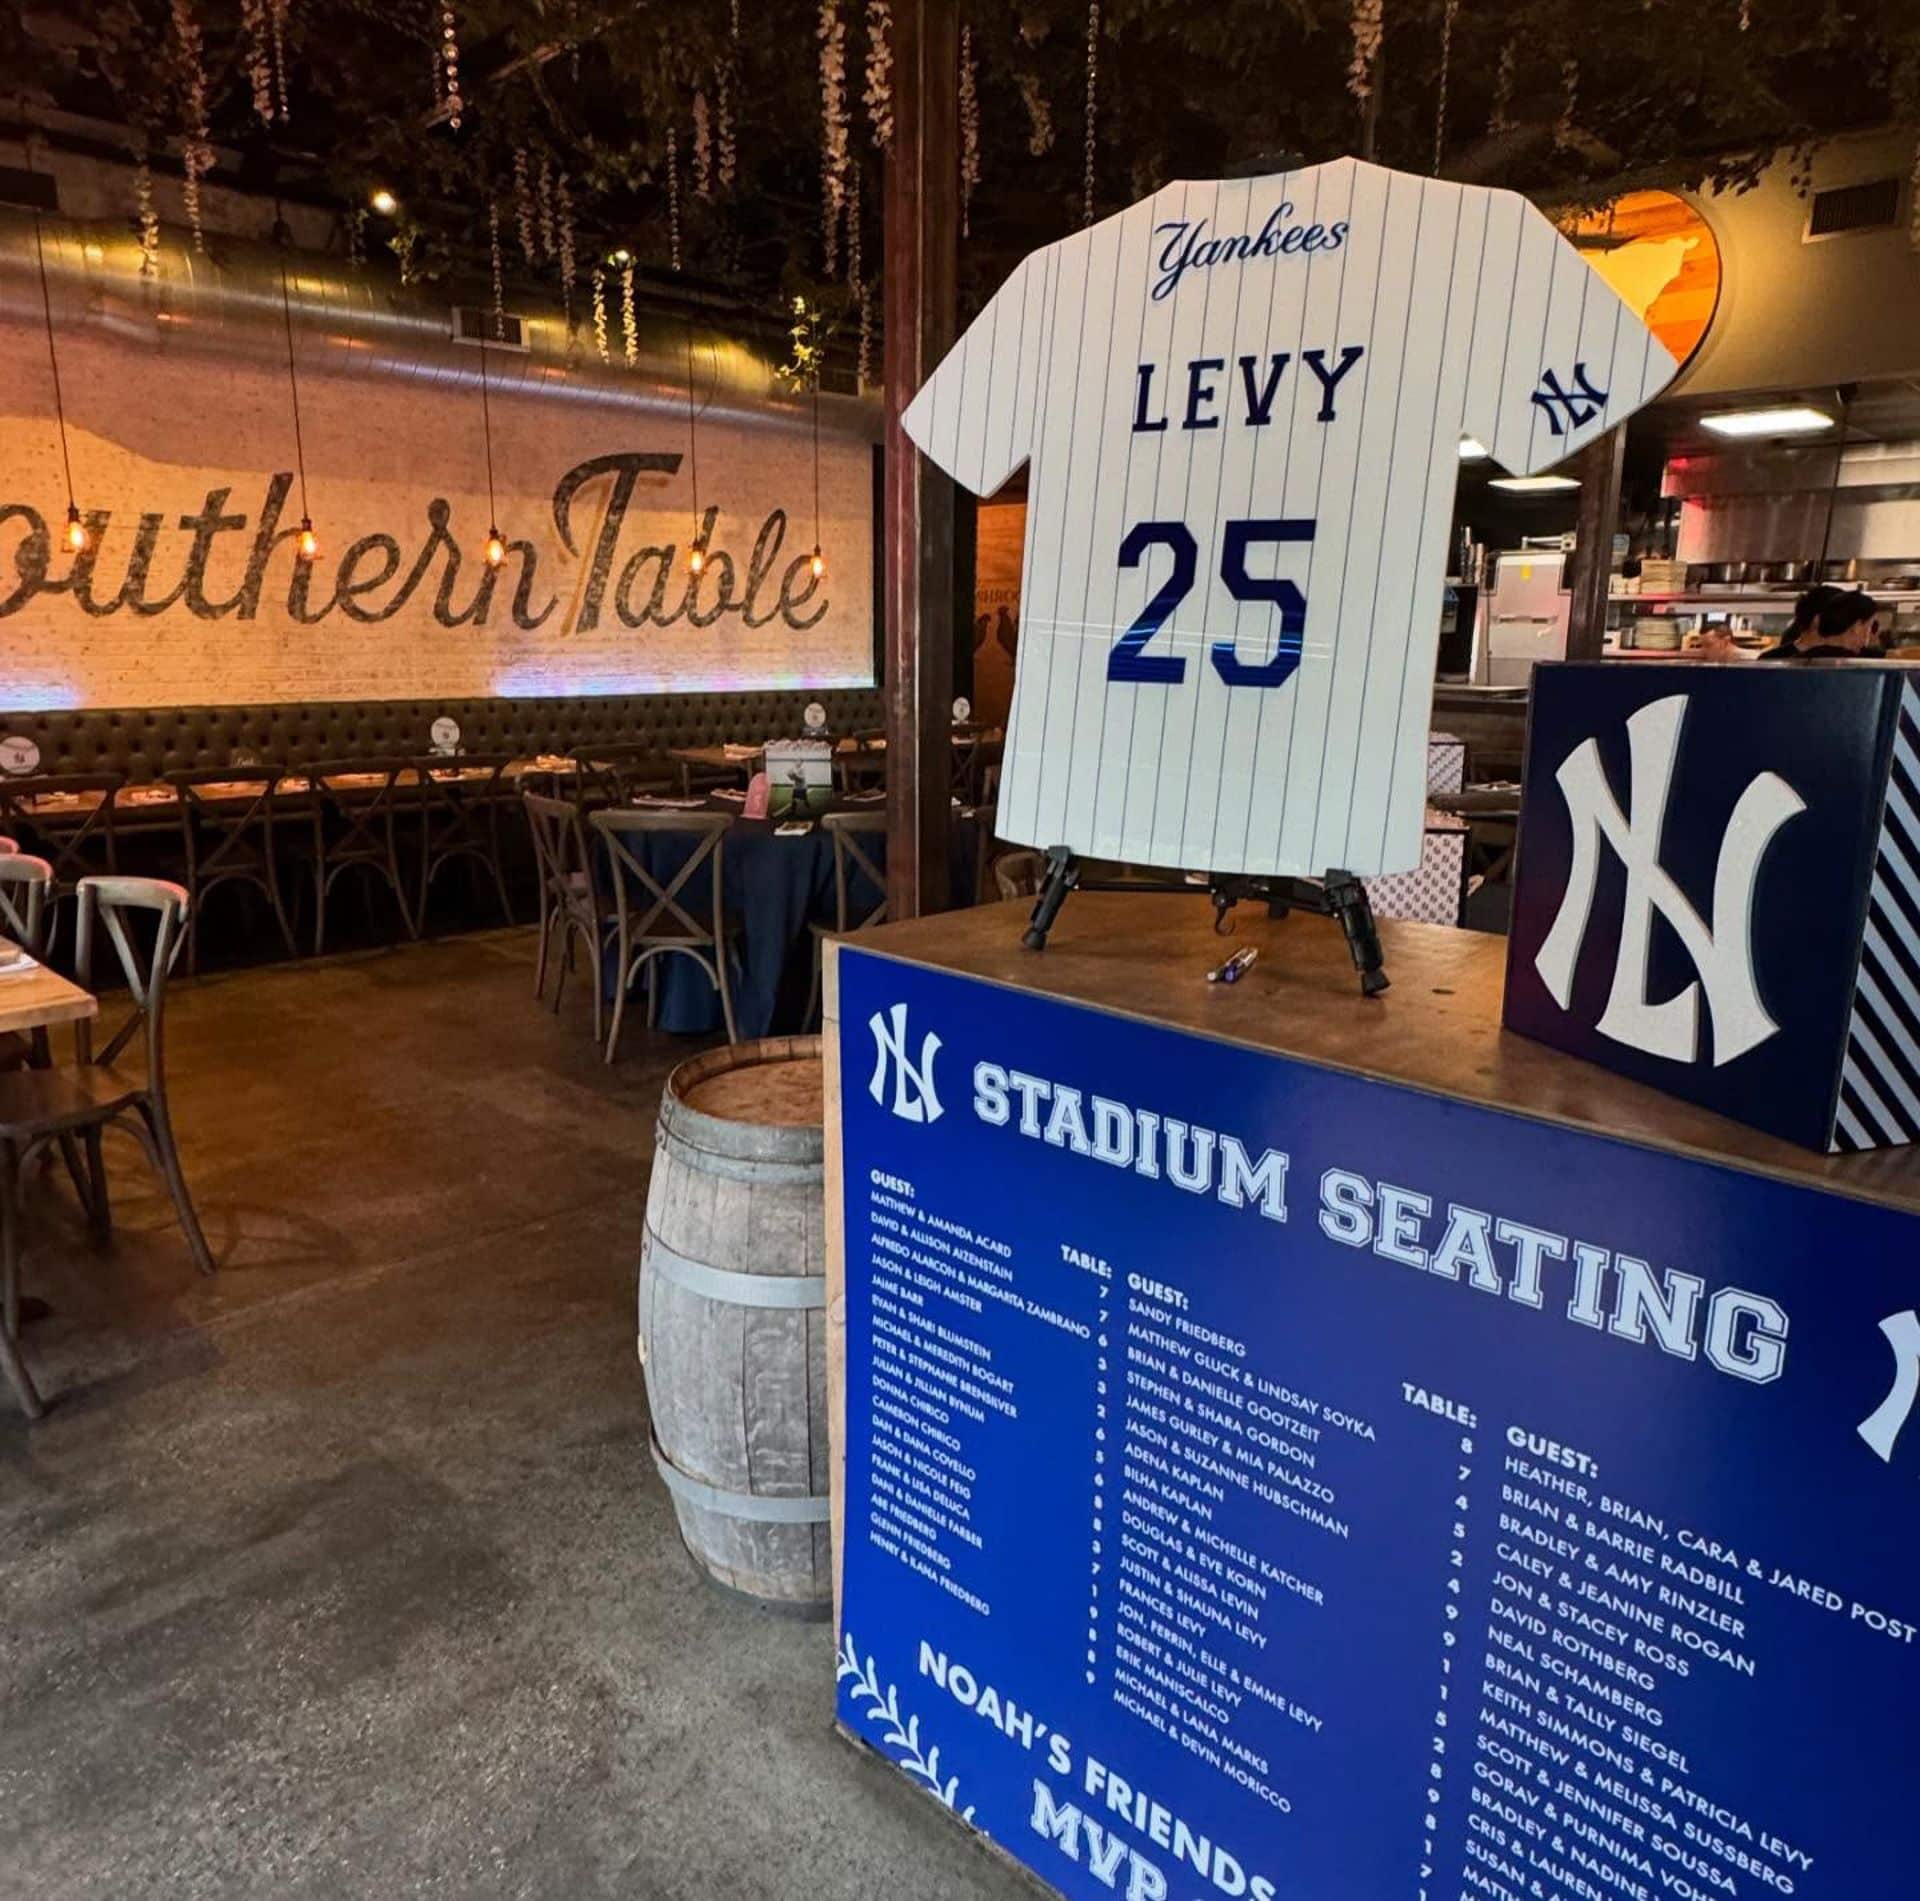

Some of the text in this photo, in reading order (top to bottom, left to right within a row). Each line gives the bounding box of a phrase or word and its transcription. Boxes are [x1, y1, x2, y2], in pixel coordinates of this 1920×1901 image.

[1151, 201, 1350, 301] Yankees
[1132, 345, 1364, 433] LEVY
[552, 453, 829, 634] Table
[1107, 518, 1317, 689] 25
[973, 1060, 1790, 1384] STADIUM SEATING
[1127, 1272, 1188, 1310] GUEST:
[1128, 1298, 1246, 1357] SANDY FRIEDBERG
[1127, 1346, 1165, 1373] BRIAN
[1182, 1371, 1243, 1409] DANIELLE
[1127, 1370, 1180, 1405] STEPHEN
[1197, 1403, 1243, 1435] SHARA
[1246, 1426, 1315, 1469] GORDON
[1128, 1322, 1191, 1358] MATTHEW
[1194, 1351, 1239, 1382] GLUCK
[1322, 1406, 1375, 1441] SOYKA
[1402, 1382, 1477, 1428] TABLE:
[1124, 1442, 1224, 1501] ADENA KAPLAN
[1124, 1464, 1212, 1520] BILHA KAPLAN
[1125, 1418, 1167, 1448] JASON
[1183, 1446, 1249, 1489] SUZANNE
[1253, 1480, 1348, 1538] HUBSCHMAN
[1126, 1395, 1166, 1422] JAMES
[1169, 1415, 1219, 1447] GURLEY
[1235, 1447, 1264, 1470] MIA
[1267, 1461, 1334, 1503] PALAZZO
[1506, 1426, 1598, 1478] GUEST:
[1121, 1533, 1159, 1562] SCOTT
[1221, 1589, 1258, 1620] LEVIN
[1122, 1489, 1178, 1525] ANDREW
[1194, 1526, 1256, 1569] MICHELLE
[1260, 1560, 1323, 1605] KATCHER
[1122, 1510, 1182, 1553] DOUGLAS
[1199, 1552, 1222, 1576] EVE
[1226, 1567, 1266, 1600] KORN
[1499, 1513, 1744, 1638] BRADLEY & AMY RINZLER
[1502, 1484, 1744, 1605] BRIAN & BARRIE RADBILL
[1677, 1530, 1738, 1568] CARA
[1746, 1559, 1762, 1579] &
[1768, 1569, 1842, 1610] JARED
[1851, 1602, 1916, 1642] POST
[1119, 1578, 1206, 1637] FRANCES LEVY
[1120, 1556, 1160, 1588] JUSTIN
[1176, 1588, 1232, 1630] SHAUNA
[1235, 1621, 1267, 1649] LEVY
[1490, 1597, 1654, 1690] DAVID ROTHBERG
[1492, 1571, 1689, 1676] JON & STACEY ROSS
[1496, 1543, 1755, 1676] CALEY & JEANINE ROGAN
[920, 1641, 1072, 1775] NOAH'S
[1116, 1644, 1141, 1669] ERIK
[1117, 1622, 1161, 1658] ROBERT
[1175, 1660, 1207, 1688] JULIE
[1211, 1680, 1241, 1707] LEVY
[1200, 1649, 1226, 1675] ELLE
[1243, 1676, 1285, 1711] EMME
[1289, 1703, 1322, 1732] LEVY
[1488, 1625, 1663, 1726] NEAL SCHAMBERG
[1113, 1689, 1166, 1732] MICHAEL
[1181, 1732, 1220, 1768] DEVIN
[1223, 1761, 1291, 1813] MORICCO
[1115, 1668, 1167, 1709] MICHAEL
[1183, 1710, 1218, 1743] LANA
[1221, 1735, 1268, 1774] MARKS
[1485, 1653, 1688, 1773] BRIAN & TALLY SIEGEL
[1474, 1761, 1539, 1806] GORAV
[1543, 1802, 1557, 1820] &
[1563, 1812, 1654, 1877] PURNIMA
[1476, 1734, 1736, 1895] SCOTT & JENNIFER SOUSSA
[1479, 1707, 1794, 1894] MATTHEW & MELISSA SUSSBERG
[1482, 1680, 1813, 1870] KEITH SIMMONS & PATRICIA LEVY
[1467, 1813, 1506, 1846] CRIS
[1511, 1840, 1525, 1858] &
[1471, 1786, 1648, 1901] BRADLEY & NADINE
